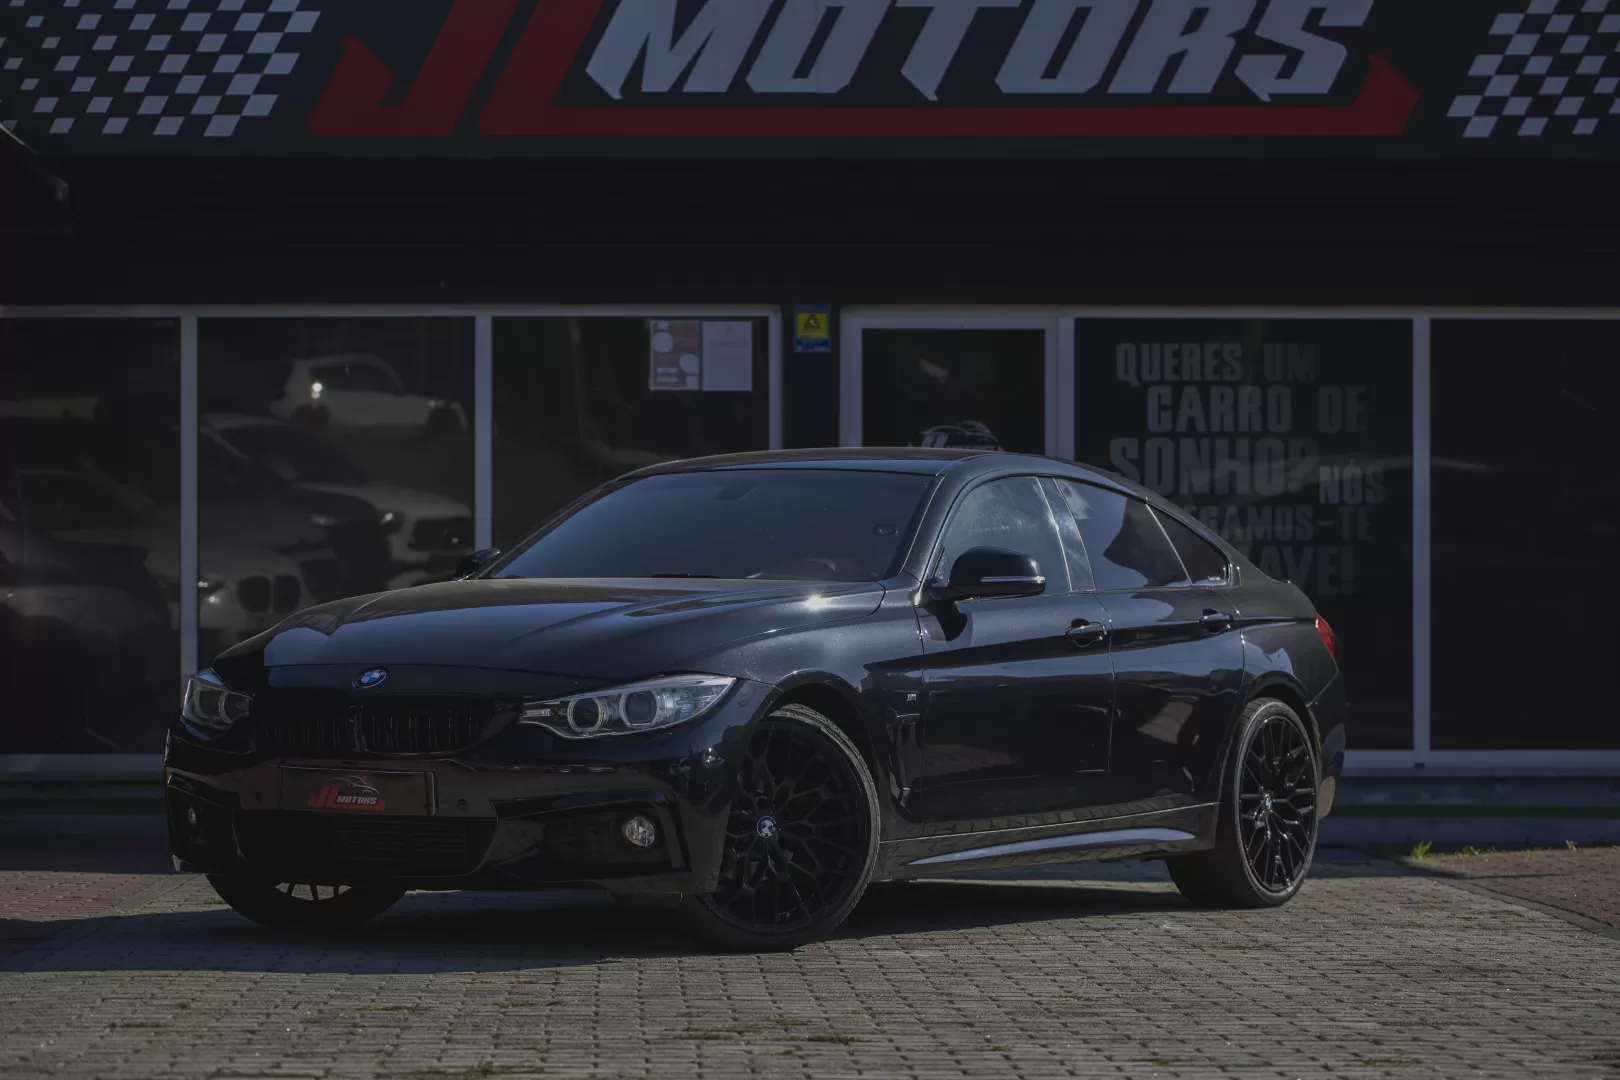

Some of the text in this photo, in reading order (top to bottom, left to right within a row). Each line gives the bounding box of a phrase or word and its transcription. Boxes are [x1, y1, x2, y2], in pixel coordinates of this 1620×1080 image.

[585, 0, 1372, 101] MOTORS
[1115, 342, 1315, 386] QUERES UM
[1146, 385, 1367, 433] CARRO DE
[1109, 437, 1319, 496] SONHO?
[337, 795, 377, 805] MOTORS
